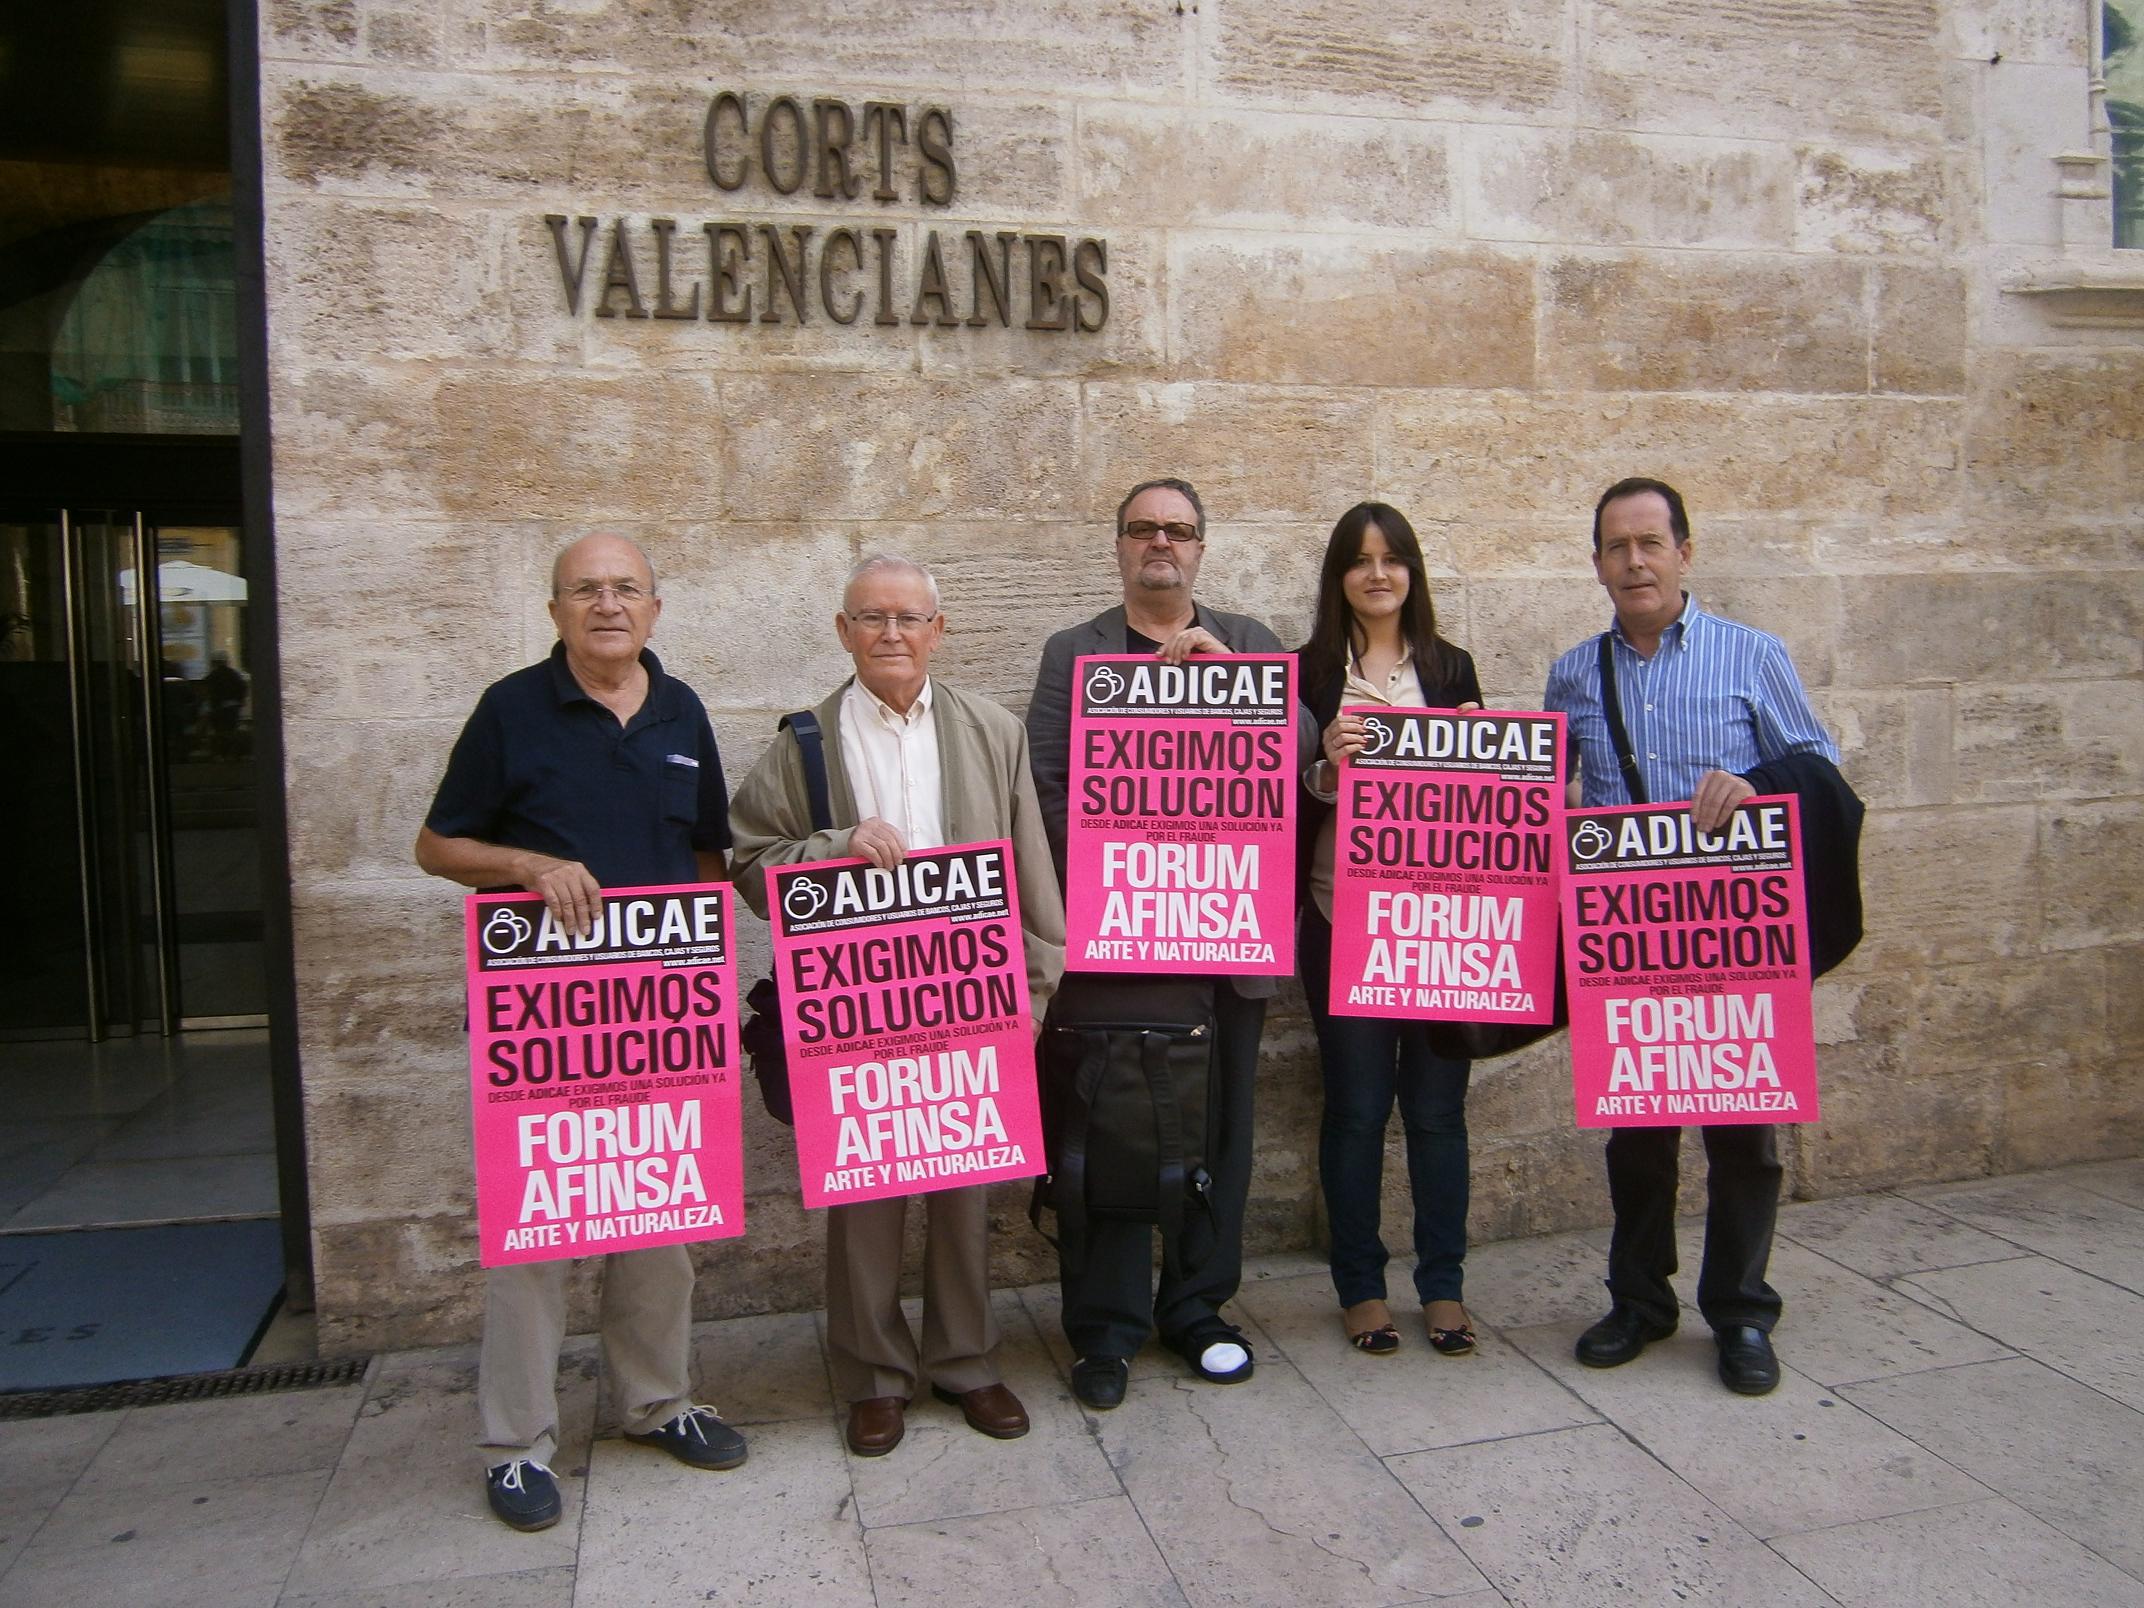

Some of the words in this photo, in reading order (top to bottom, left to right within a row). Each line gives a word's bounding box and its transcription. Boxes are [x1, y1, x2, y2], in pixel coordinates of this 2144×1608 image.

[704, 90, 957, 206] CORTS
[545, 213, 1110, 332] VALENCIANES
[1127, 665, 1282, 704] ADICAE
[1396, 718, 1552, 761] ADICAE
[1080, 820, 1111, 830] DESDE
[1113, 821, 1149, 830] ADICAE
[1151, 821, 1196, 831] EXIGIMOS
[1198, 822, 1218, 831] UNA
[1270, 823, 1283, 832] YA
[1146, 832, 1165, 841] POR
[1167, 832, 1178, 841] EL
[1180, 832, 1216, 842] FRAUDE
[833, 853, 1002, 915] ADICAE
[1102, 843, 1259, 889] FORUM
[1346, 869, 1377, 879] DESDE
[1379, 870, 1415, 880] ADICAE
[1417, 872, 1461, 882] EXIGIMOS
[1463, 874, 1483, 883] UNA
[1535, 877, 1547, 886] YA
[1412, 882, 1430, 891] POR
[1432, 883, 1443, 892] EL
[1445, 883, 1481, 893] FRAUDE
[1098, 890, 1260, 939] AFINSA
[1367, 891, 1523, 941] FORUM
[1084, 940, 1132, 959] ARTE
[1136, 941, 1149, 960] Y
[1153, 941, 1275, 962] NATURALEZA
[1361, 938, 1521, 988] AFINSA
[1347, 985, 1395, 1005] ARTE
[1398, 987, 1411, 1006] Y
[1415, 988, 1534, 1012] NATURALEZA
[1579, 977, 1611, 987] DESDE
[1613, 975, 1651, 986] ADICAE
[1653, 973, 1702, 984] EXIGIMOS
[1704, 972, 1726, 982] UNA
[1782, 969, 1796, 979] YA
[1649, 985, 1670, 995] POR
[1671, 985, 1683, 994] EL
[1685, 983, 1724, 994] FRAUDE
[799, 1044, 833, 1058] DESDE
[836, 1038, 875, 1053] ADICAE
[877, 1031, 926, 1047] EXIGIMOS
[928, 1028, 950, 1040] UNA
[1004, 1019, 1018, 1030] YA
[1604, 993, 1774, 1043] FORUM
[873, 1047, 894, 1059] POR
[896, 1045, 908, 1056] EL
[909, 1040, 949, 1054] FRAUDE
[1608, 1041, 1780, 1092] AFINSA
[488, 1090, 525, 1104] DESDE
[528, 1086, 571, 1100] ADICAE
[574, 1081, 627, 1096] EXIGIMOS
[629, 1079, 653, 1091] UNA
[711, 1072, 726, 1083] YA
[569, 1097, 592, 1109] POR
[594, 1095, 607, 1106] EL
[609, 1091, 650, 1105] FRAUDE
[827, 1045, 1000, 1115] FORUM
[1595, 1095, 1645, 1115] ARTE
[1648, 1095, 1663, 1113] Y
[1667, 1091, 1797, 1113] NATURALEZA
[517, 1099, 702, 1167] FORUM
[835, 1096, 1008, 1167] AFINSA
[518, 1153, 706, 1223] AFINSA
[823, 1166, 875, 1193] ARTE
[877, 1163, 893, 1184] Y
[896, 1145, 1025, 1182] NATURALEZA
[503, 1223, 560, 1251] ARTE
[565, 1221, 580, 1243] Y
[585, 1204, 723, 1241] NATURALEZA
